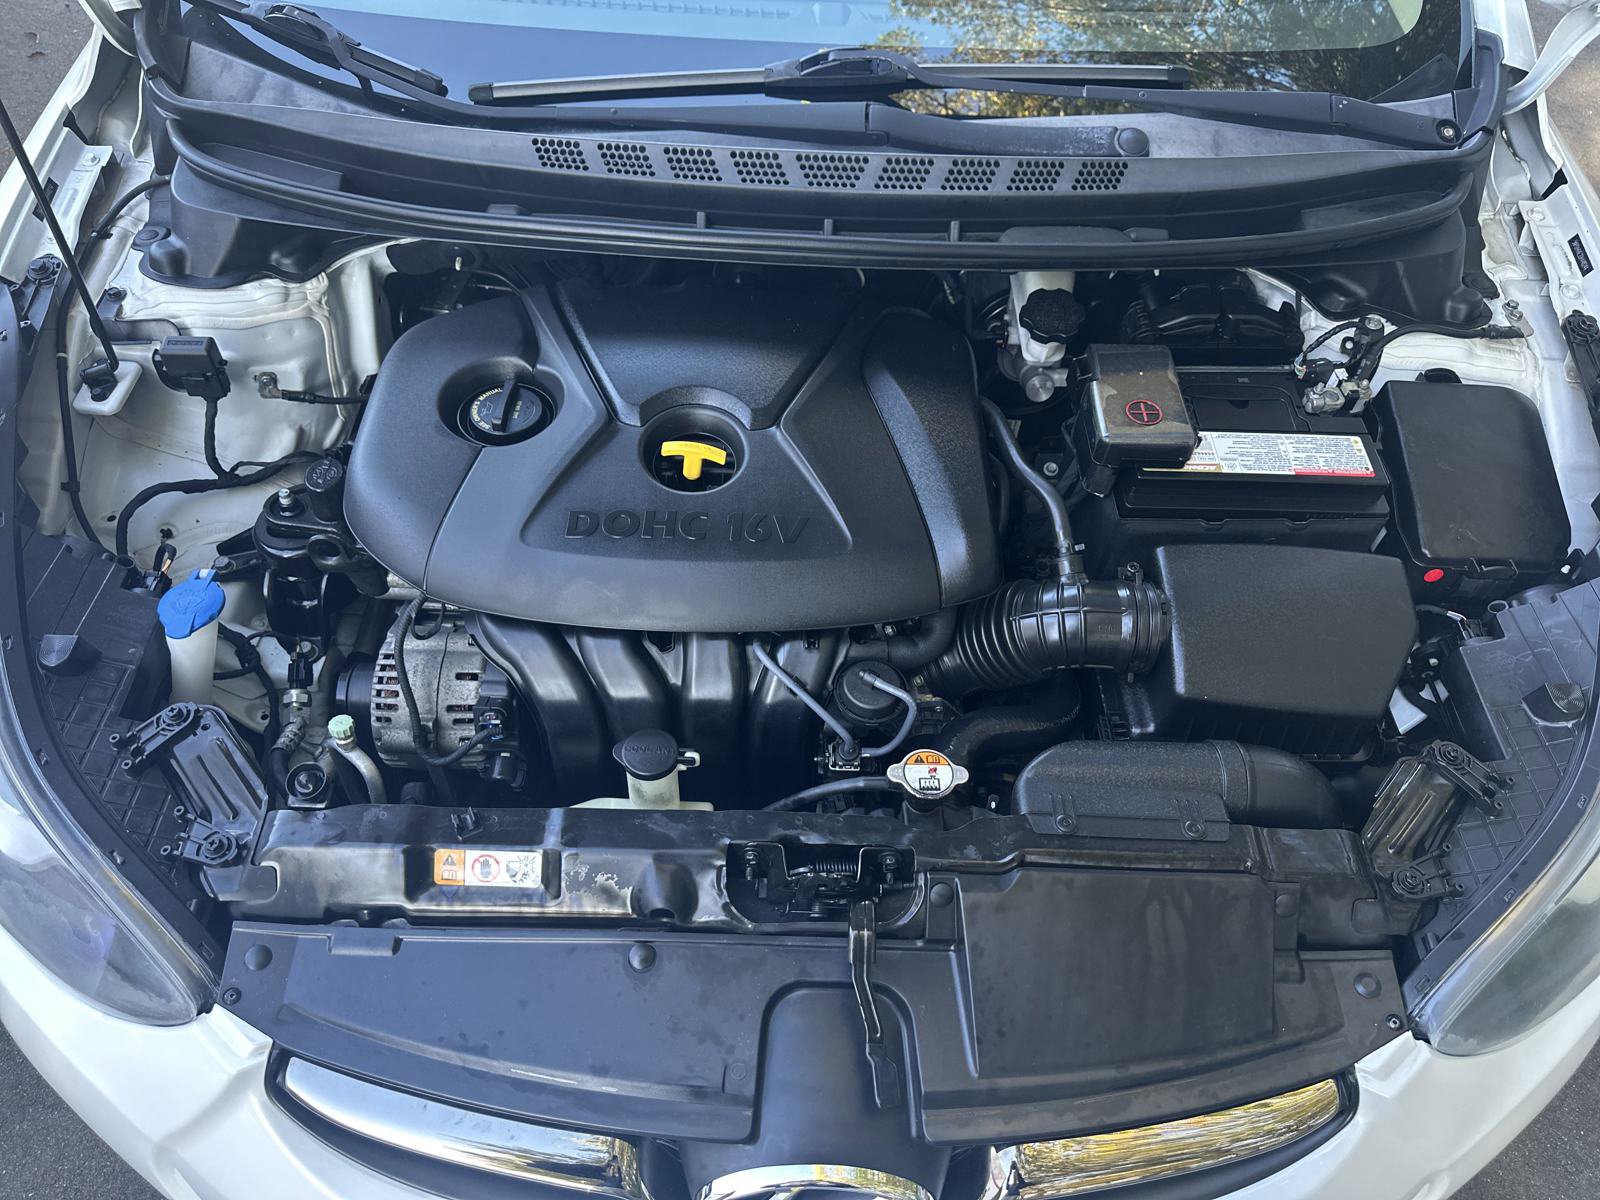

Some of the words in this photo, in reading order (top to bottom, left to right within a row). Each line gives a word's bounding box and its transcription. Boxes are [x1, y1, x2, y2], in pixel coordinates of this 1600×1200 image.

[479, 388, 502, 400] MANUAL
[564, 509, 710, 541] DOHC
[726, 511, 811, 544] 16V
